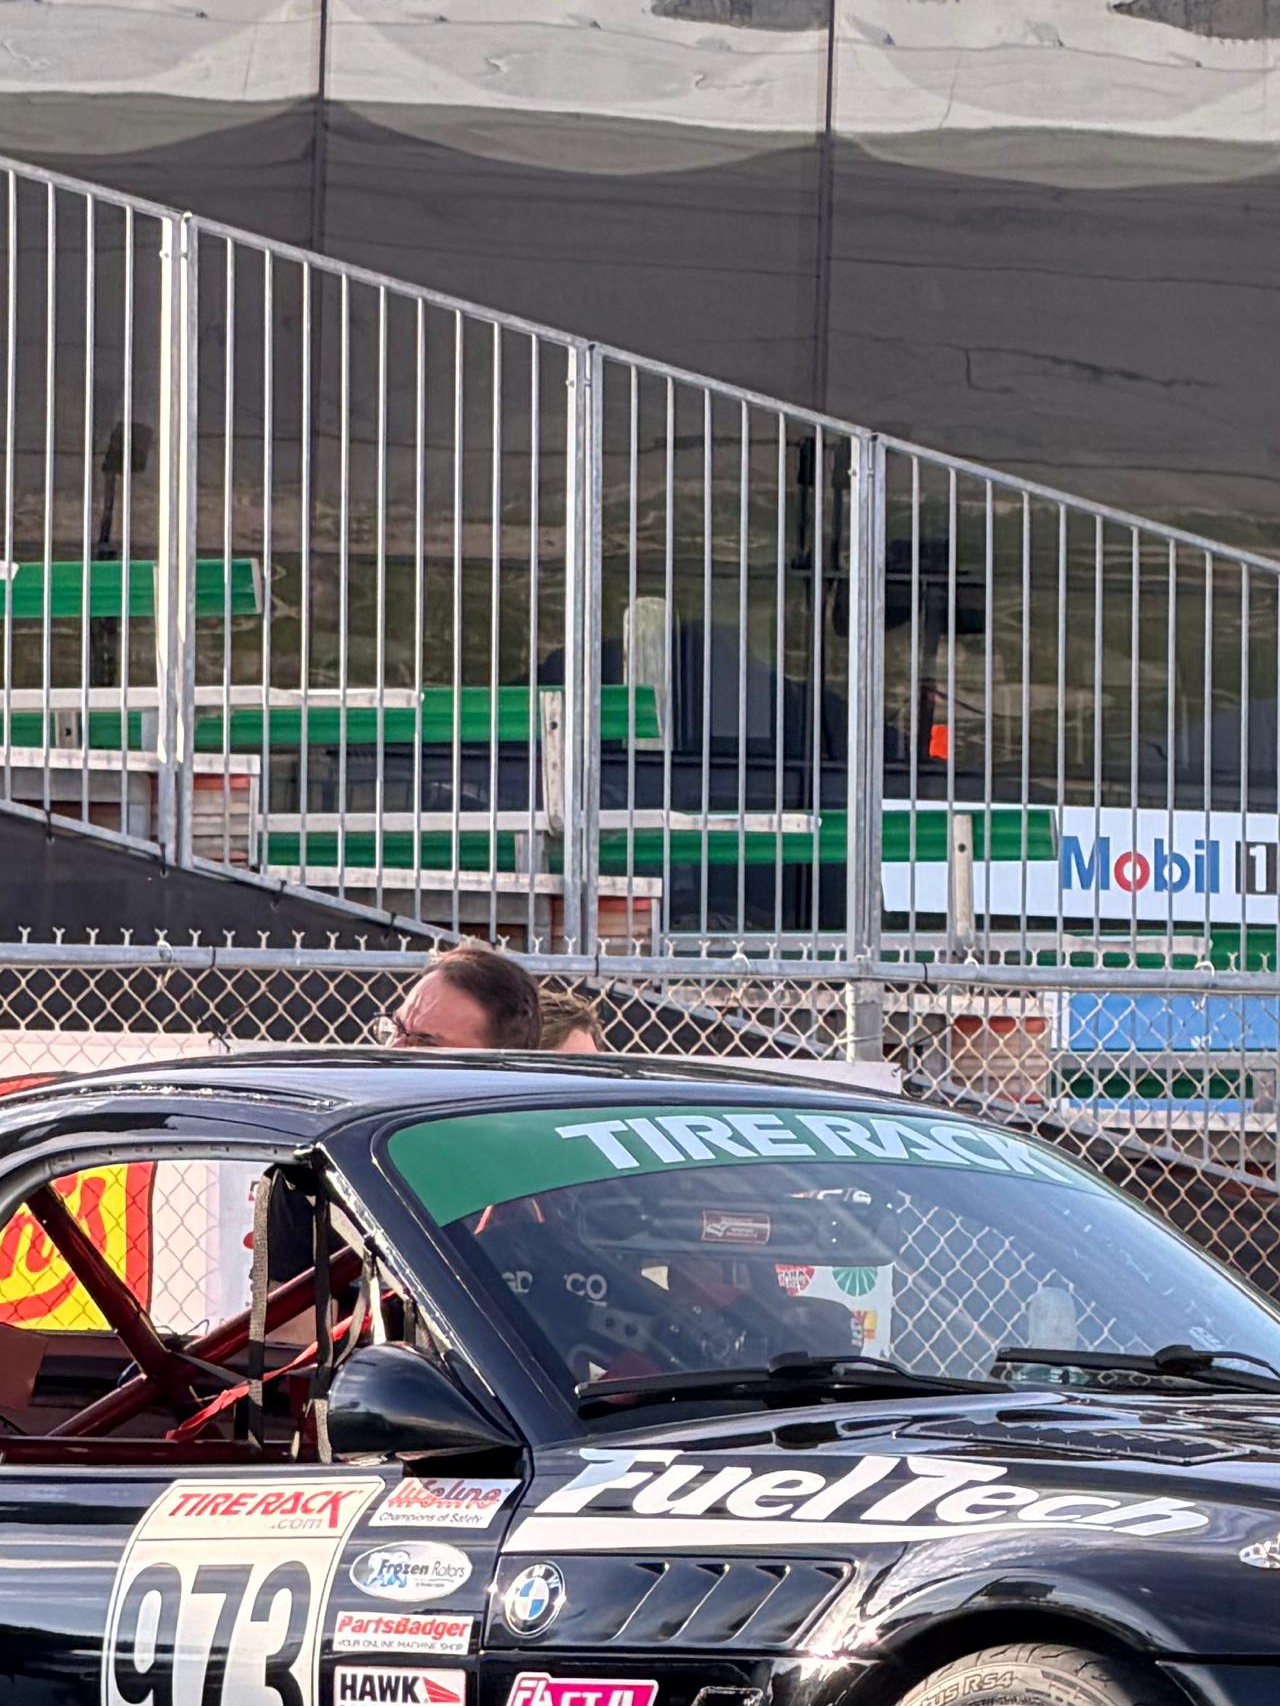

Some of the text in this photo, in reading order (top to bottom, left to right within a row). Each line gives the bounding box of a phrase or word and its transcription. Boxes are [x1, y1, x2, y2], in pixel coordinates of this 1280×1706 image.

[1059, 834, 1221, 895] Mobil
[554, 1113, 1075, 1184] TIRE RACK
[168, 1490, 356, 1529] TIRE RACK
[534, 1448, 1210, 1537] FuelTech
[378, 1559, 466, 1578] Frozen Rotors
[338, 1615, 471, 1641] PartsBadger
[340, 1673, 421, 1704] HAWK
[962, 1670, 1015, 1695] RS4
